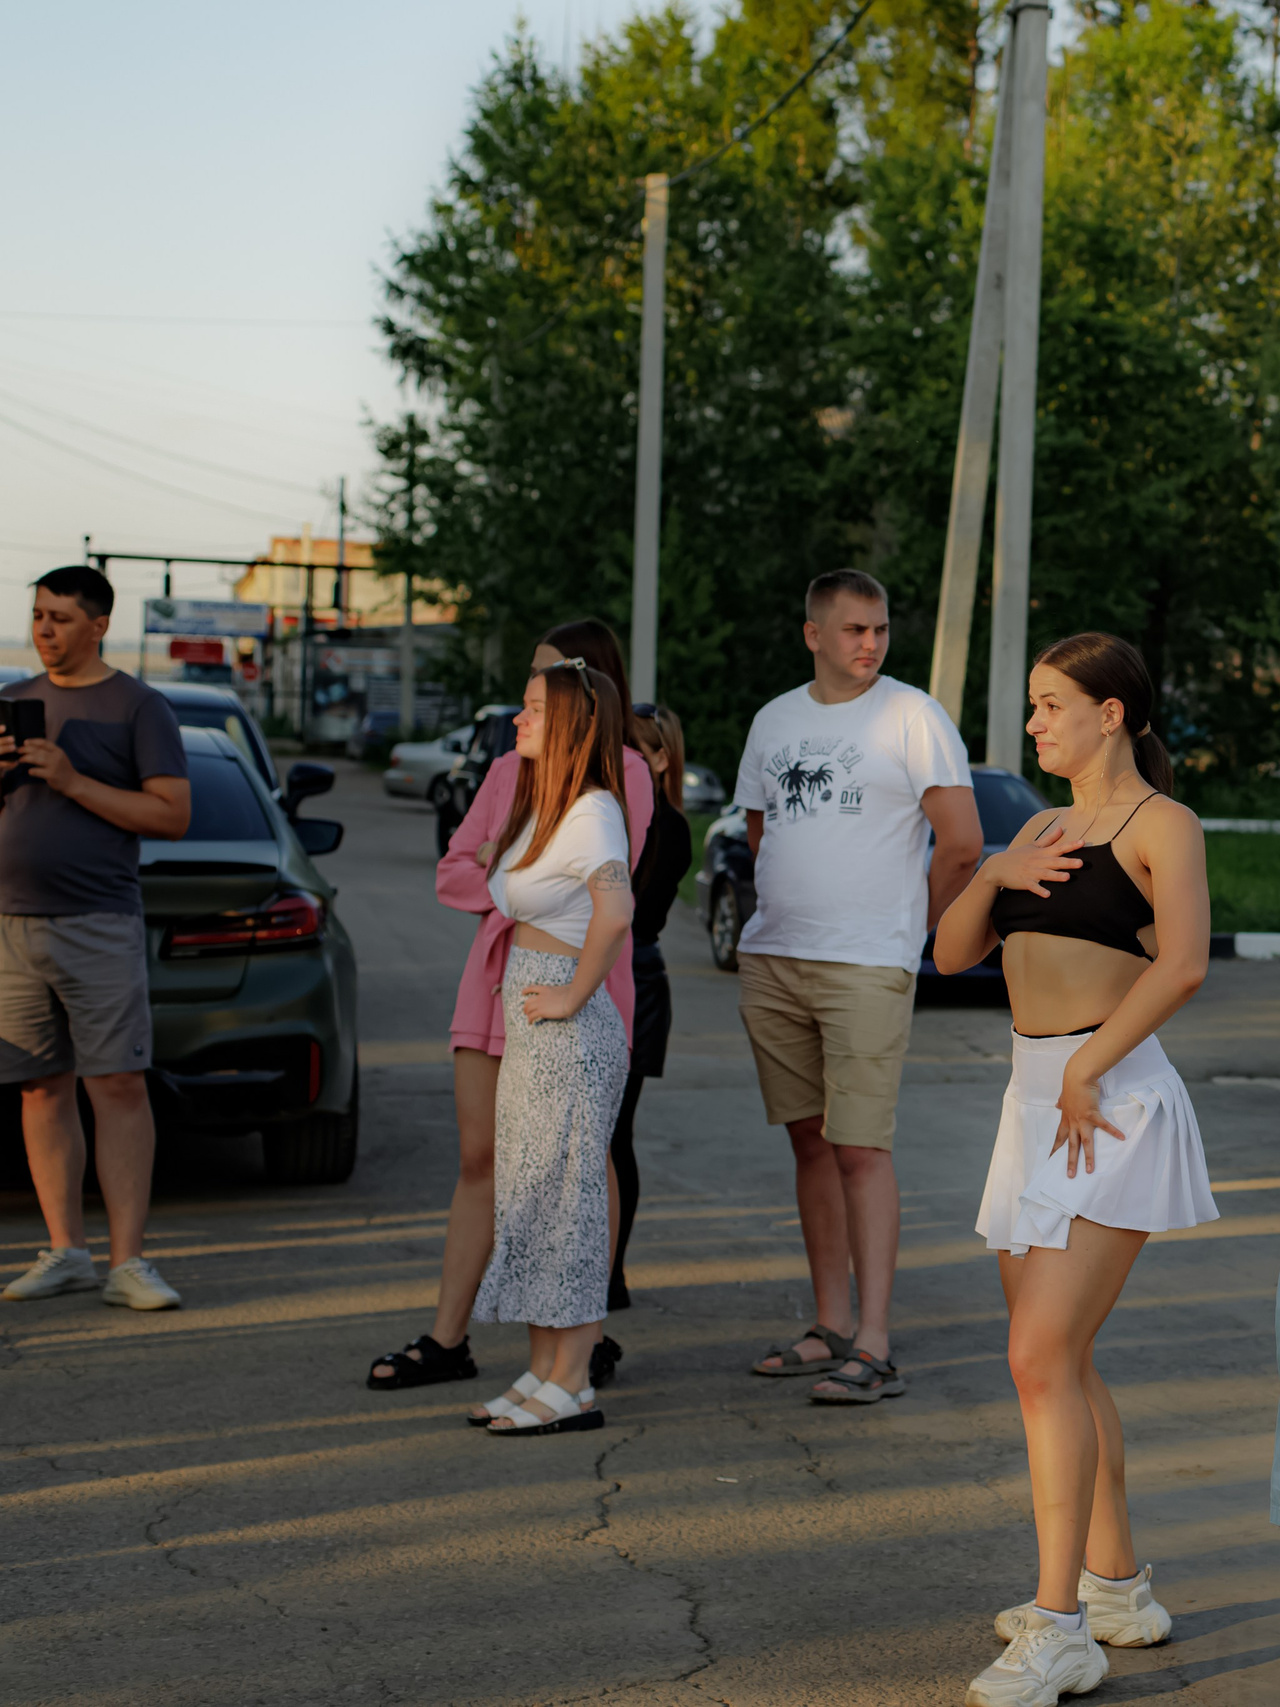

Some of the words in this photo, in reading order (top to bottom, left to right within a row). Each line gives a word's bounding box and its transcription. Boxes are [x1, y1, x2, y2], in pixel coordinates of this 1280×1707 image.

[764, 744, 793, 776] THE
[799, 736, 843, 757] SURF
[840, 790, 863, 805] DIV
